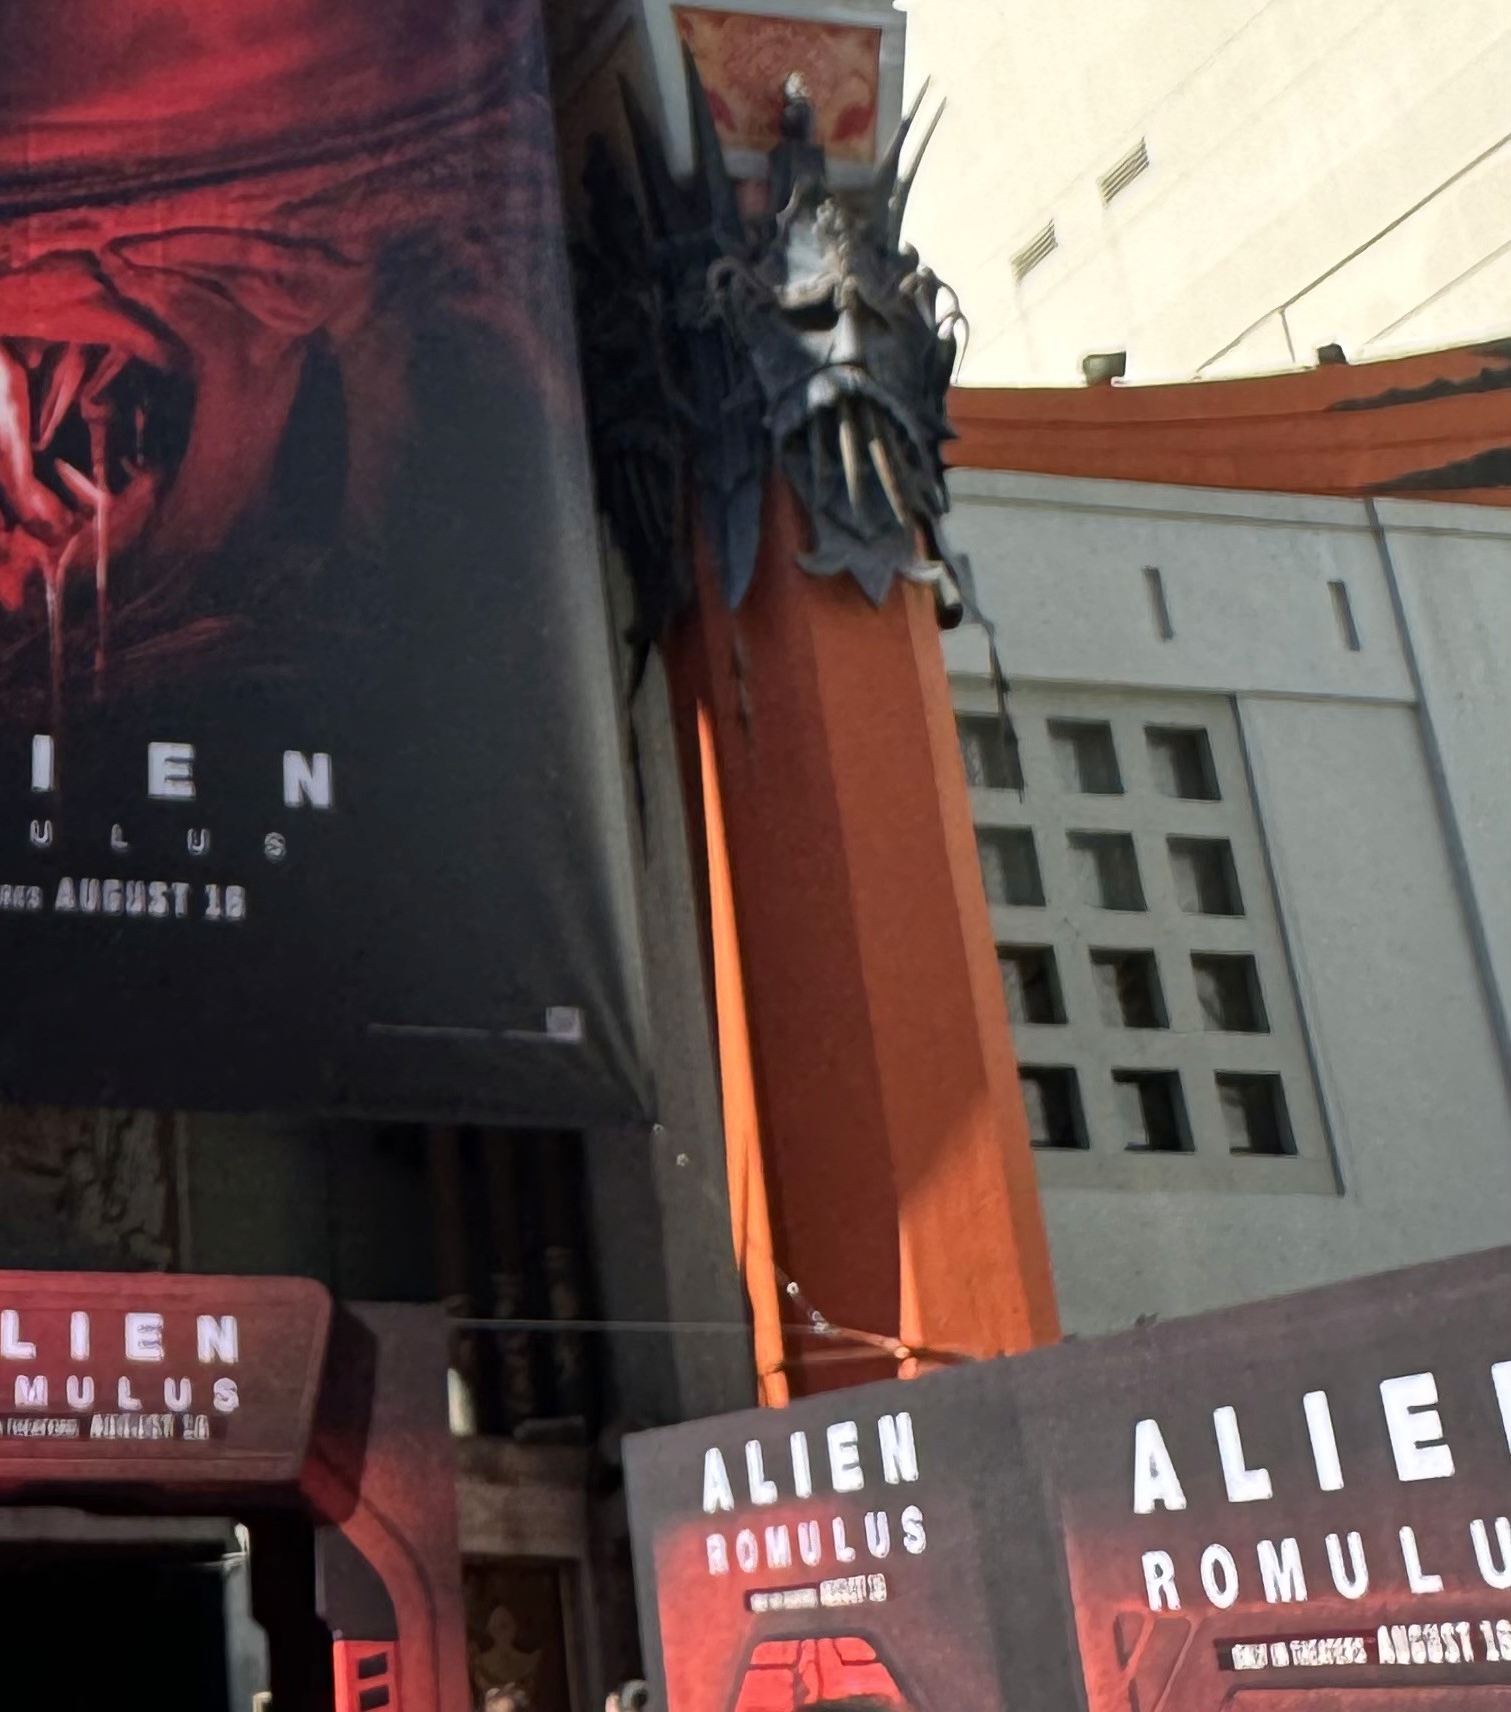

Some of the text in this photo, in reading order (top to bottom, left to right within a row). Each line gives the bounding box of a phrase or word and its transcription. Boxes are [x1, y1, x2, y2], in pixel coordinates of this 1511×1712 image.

[55, 877, 189, 919] AUGUST
[702, 1412, 919, 1514] ALIEN
[1133, 1360, 1511, 1514] ALIE
[705, 1504, 927, 1576] ROMULUS
[1141, 1516, 1511, 1612] ROMULU
